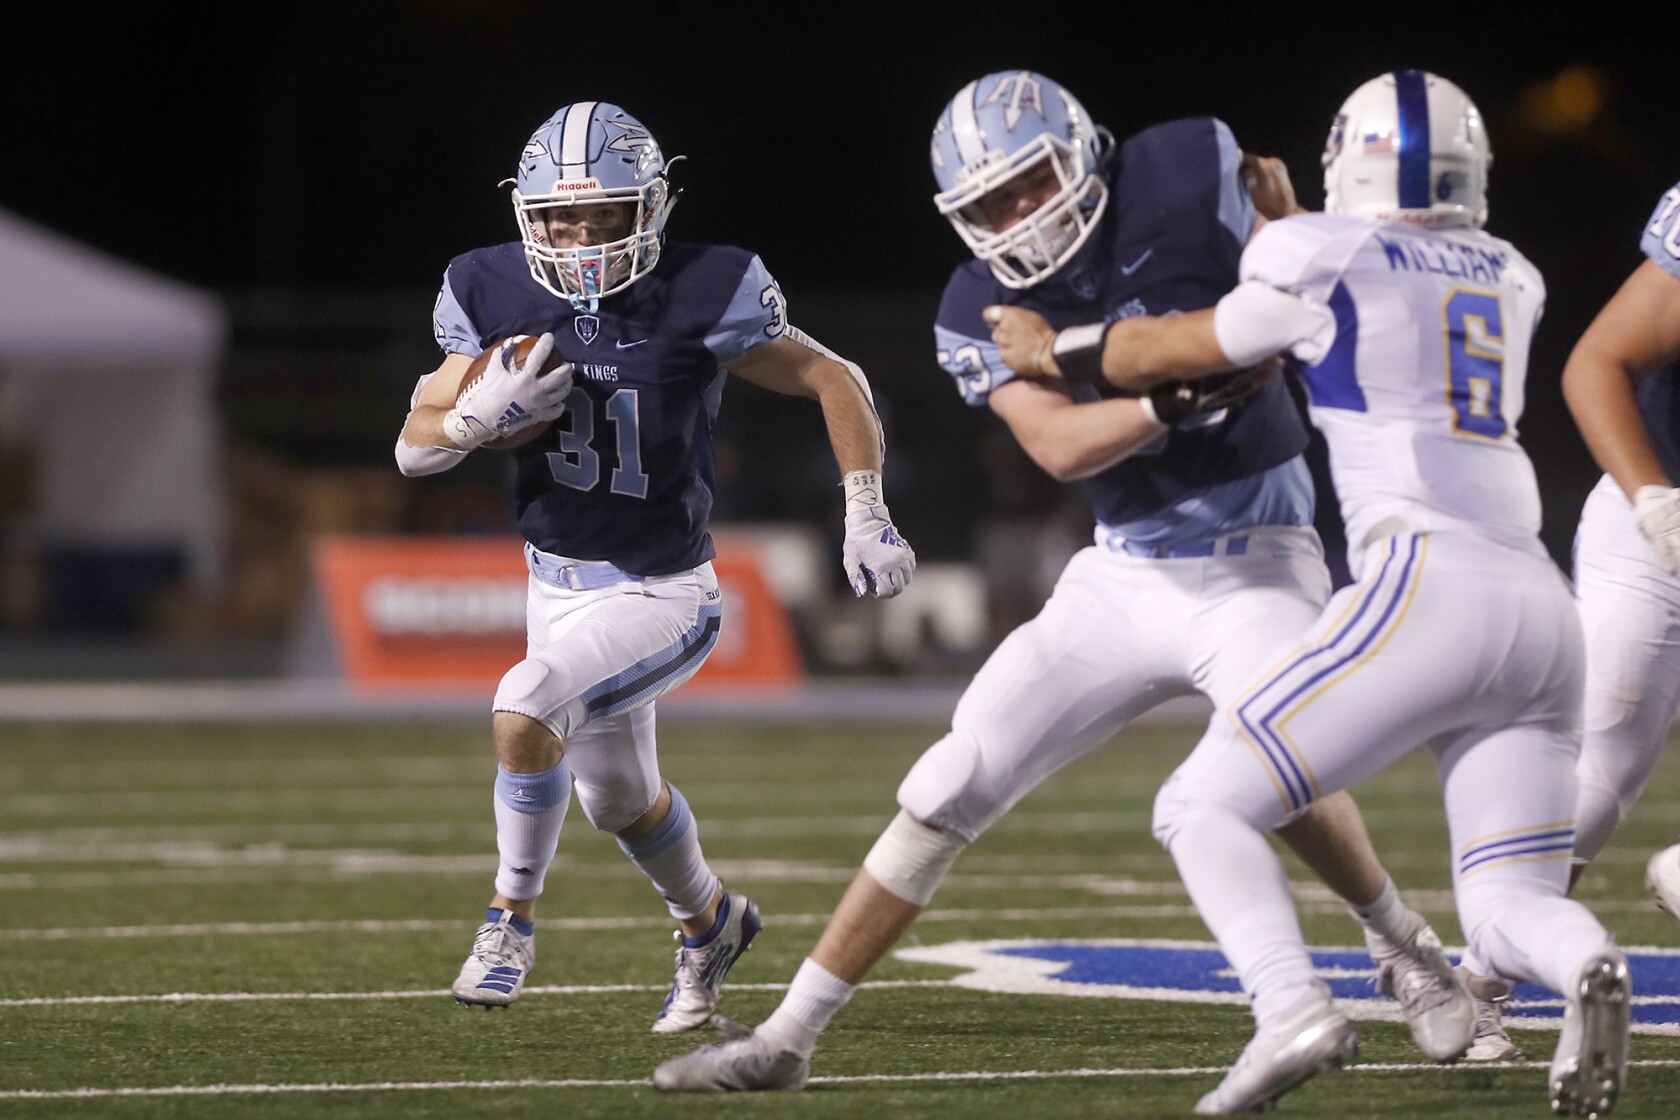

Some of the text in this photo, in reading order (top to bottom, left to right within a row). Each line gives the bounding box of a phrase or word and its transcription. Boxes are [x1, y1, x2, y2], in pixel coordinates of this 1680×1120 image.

[557, 182, 596, 192] Riddell
[1374, 232, 1523, 292] WILLIAM
[760, 284, 786, 339] 3
[583, 364, 618, 382] KINGS
[1441, 284, 1508, 443] 6
[496, 413, 533, 430] adidas
[545, 388, 649, 500] 31
